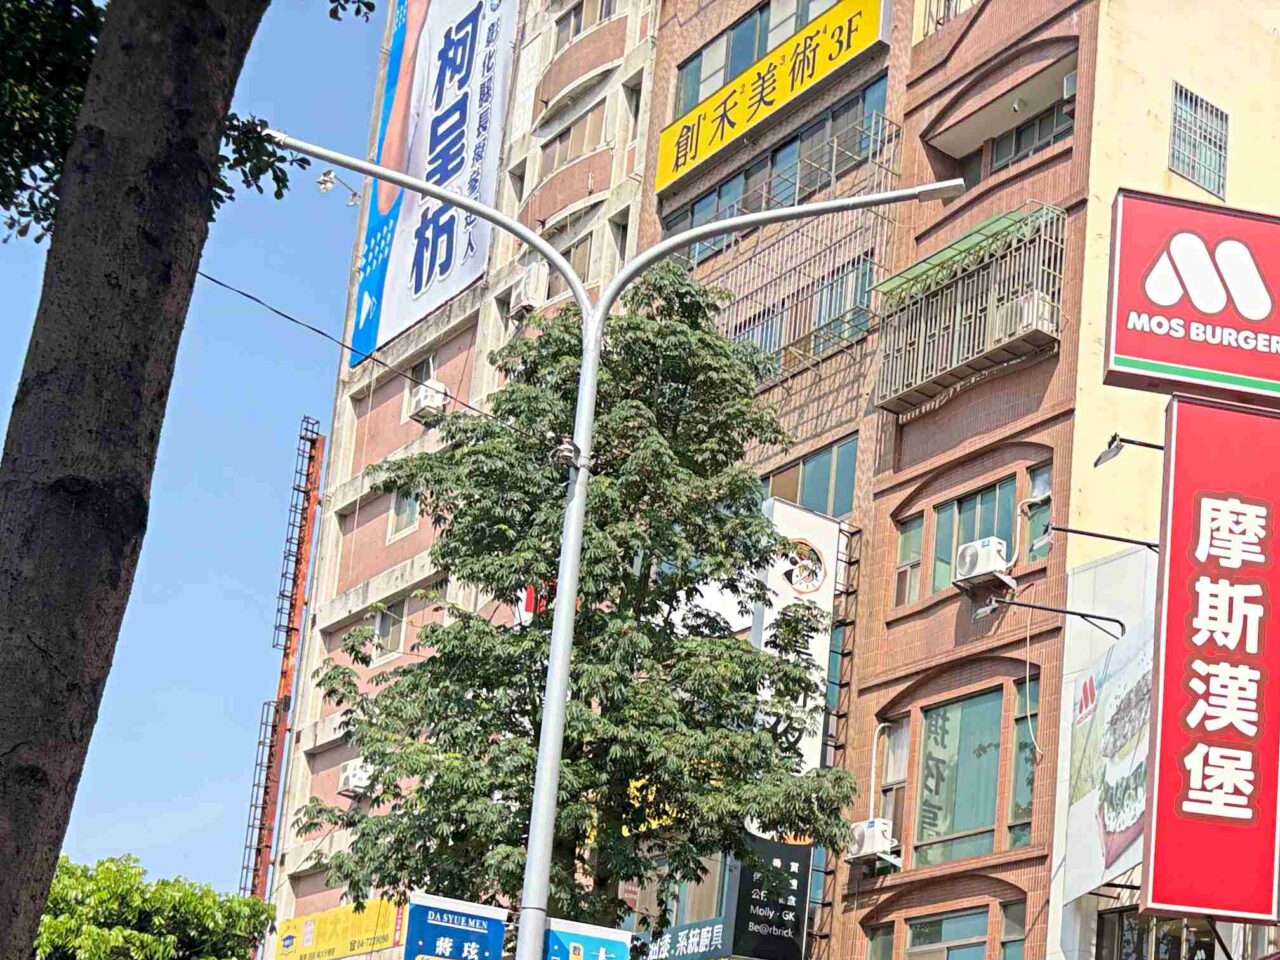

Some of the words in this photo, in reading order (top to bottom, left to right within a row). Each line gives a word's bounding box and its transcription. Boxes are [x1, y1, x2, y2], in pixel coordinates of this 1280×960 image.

[1127, 311, 1185, 339] MOS
[1181, 497, 1267, 821] 摩斯漢堡
[750, 905, 775, 920] Molly
[748, 922, 794, 938] Be@rbrick
